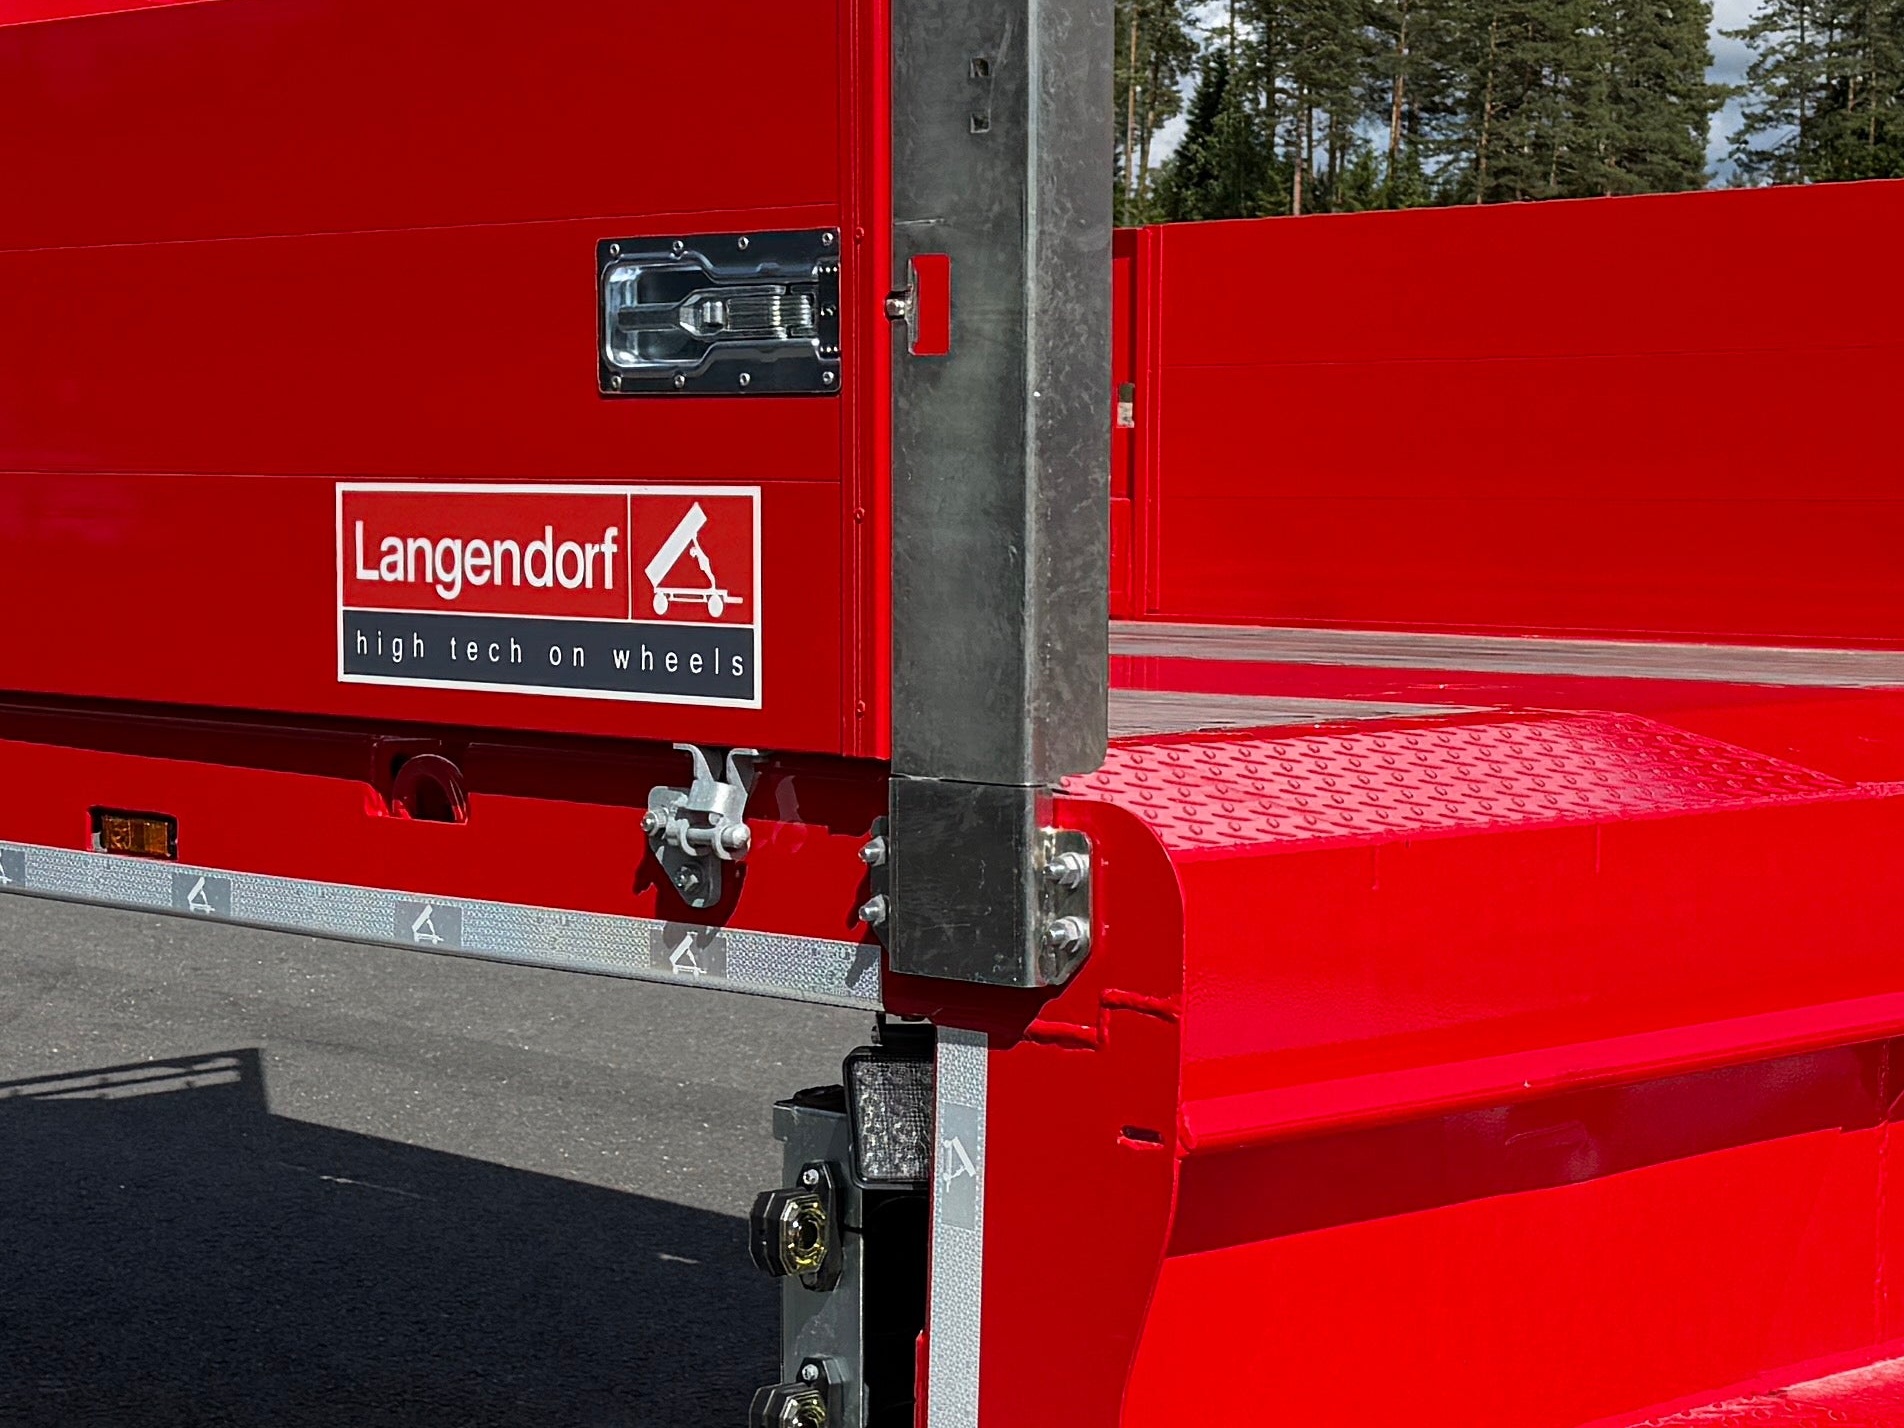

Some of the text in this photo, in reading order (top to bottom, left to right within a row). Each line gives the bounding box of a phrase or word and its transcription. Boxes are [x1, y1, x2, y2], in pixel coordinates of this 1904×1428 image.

[354, 519, 619, 601] Langendorf
[356, 629, 744, 677] high tech on wheels
